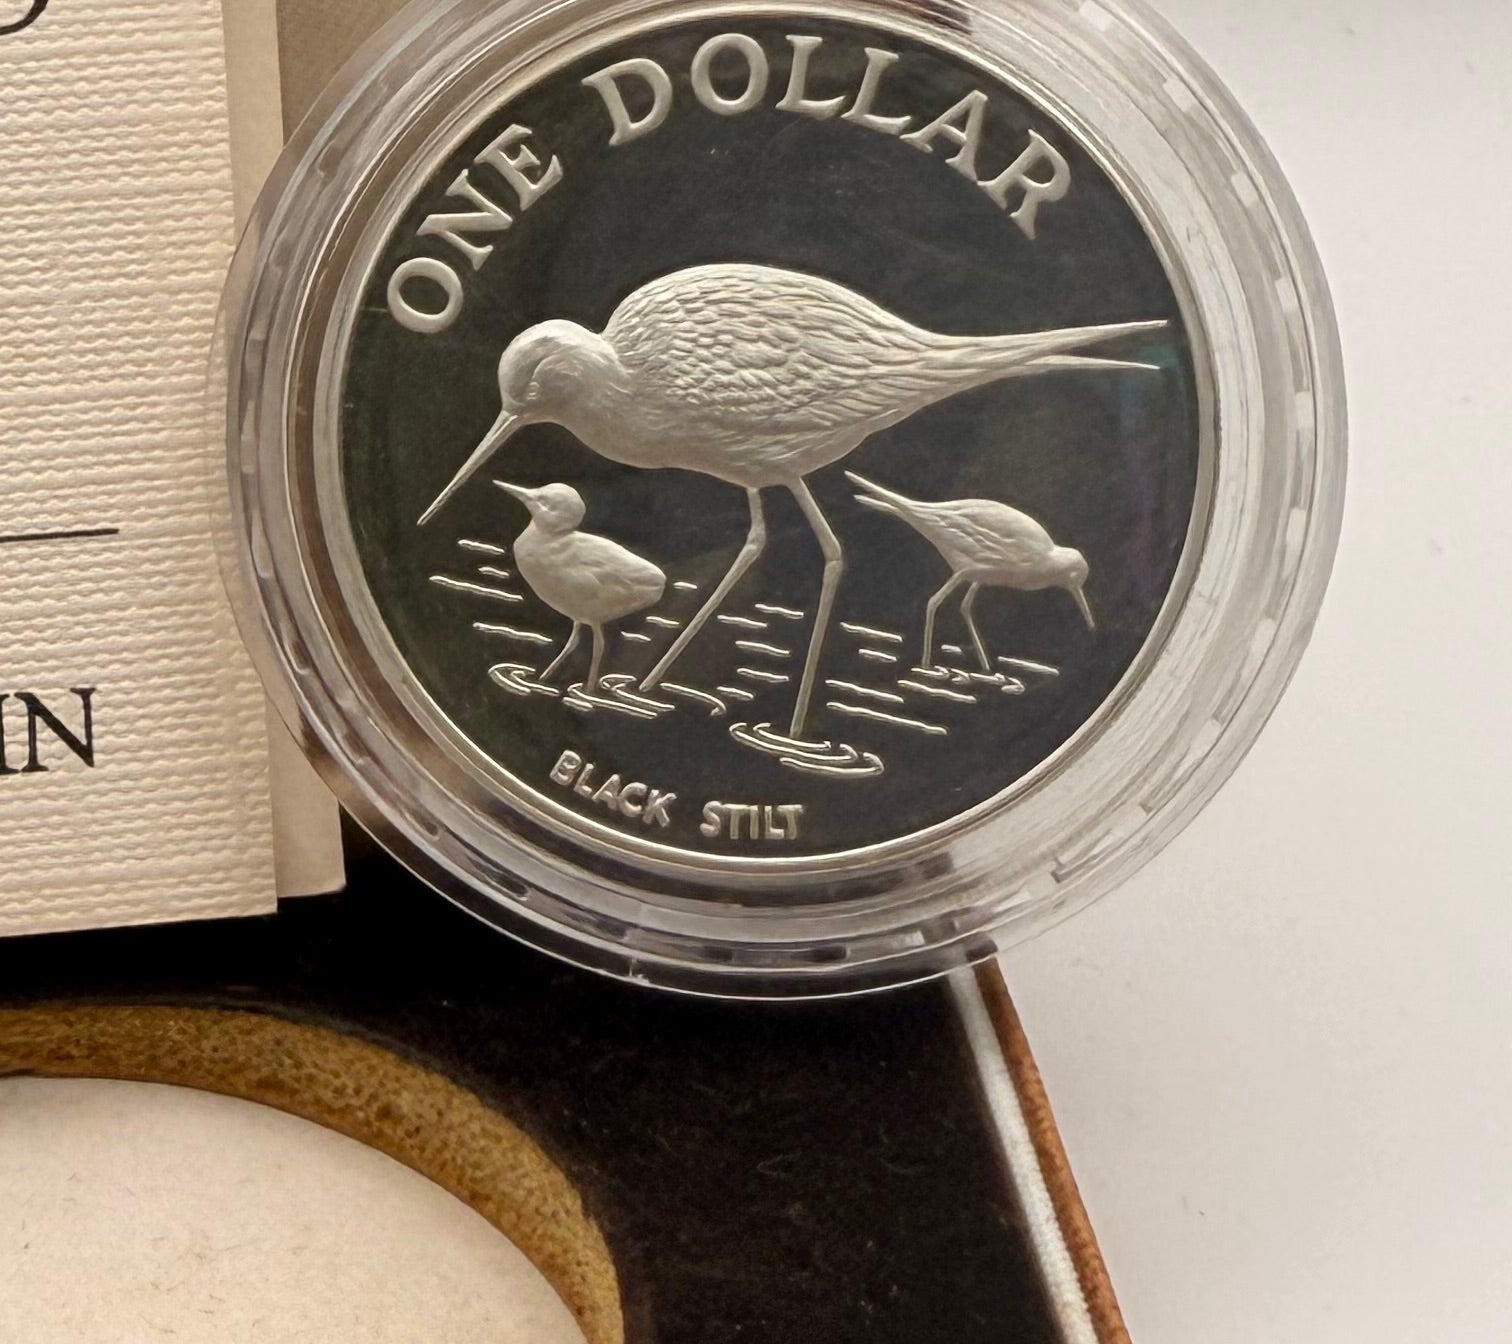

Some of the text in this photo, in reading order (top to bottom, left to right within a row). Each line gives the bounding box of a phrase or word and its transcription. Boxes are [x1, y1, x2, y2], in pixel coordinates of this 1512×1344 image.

[386, 32, 1072, 333] ONE DOLLAR
[549, 750, 805, 841] BLACK STILT
